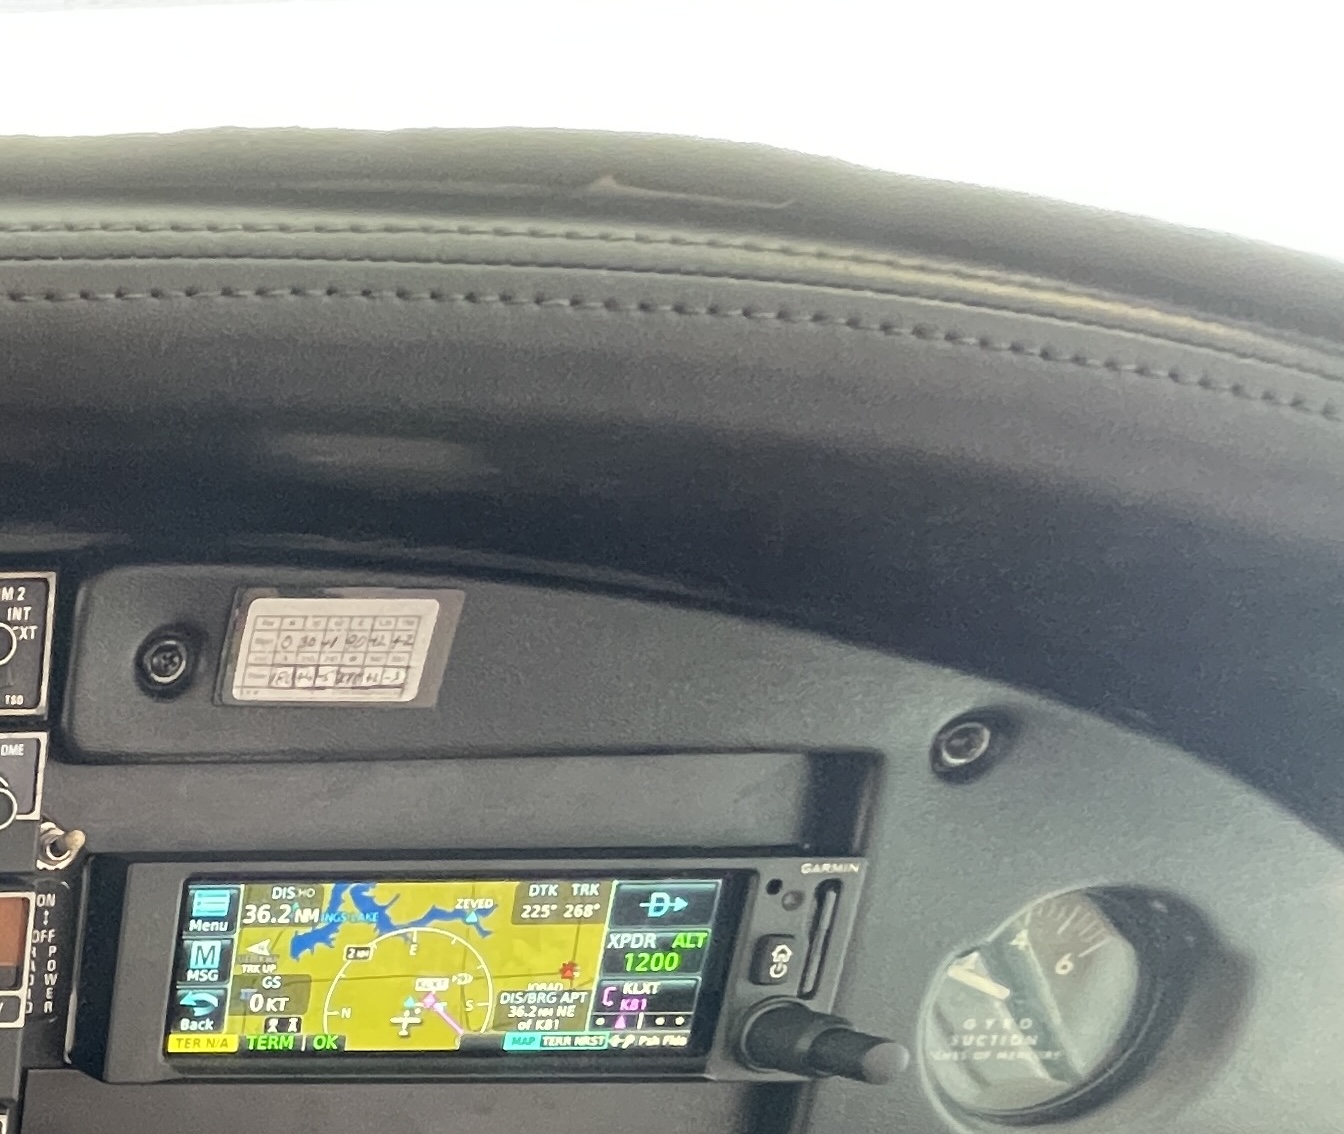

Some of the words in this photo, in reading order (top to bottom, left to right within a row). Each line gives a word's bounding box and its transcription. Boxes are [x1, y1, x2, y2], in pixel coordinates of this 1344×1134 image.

[16, 587, 26, 601] 2
[7, 608, 32, 621] INT
[0, 744, 24, 757] DME
[800, 862, 860, 874] GARMIN
[272, 886, 296, 900] DIS
[528, 884, 559, 897] DTK
[571, 883, 600, 896] TRK
[242, 904, 292, 924] 36.2
[294, 908, 320, 924] NM
[520, 904, 558, 919] 225°
[563, 903, 601, 918] 268°
[188, 920, 228, 932] Menu
[607, 933, 657, 949] XPDR
[671, 932, 708, 949] ALT
[623, 952, 680, 972] 1200
[186, 970, 219, 982] MSG
[622, 981, 661, 995] KLXT
[180, 1018, 214, 1032] Back
[246, 1035, 295, 1050] TERM
[312, 1036, 338, 1049] OK
